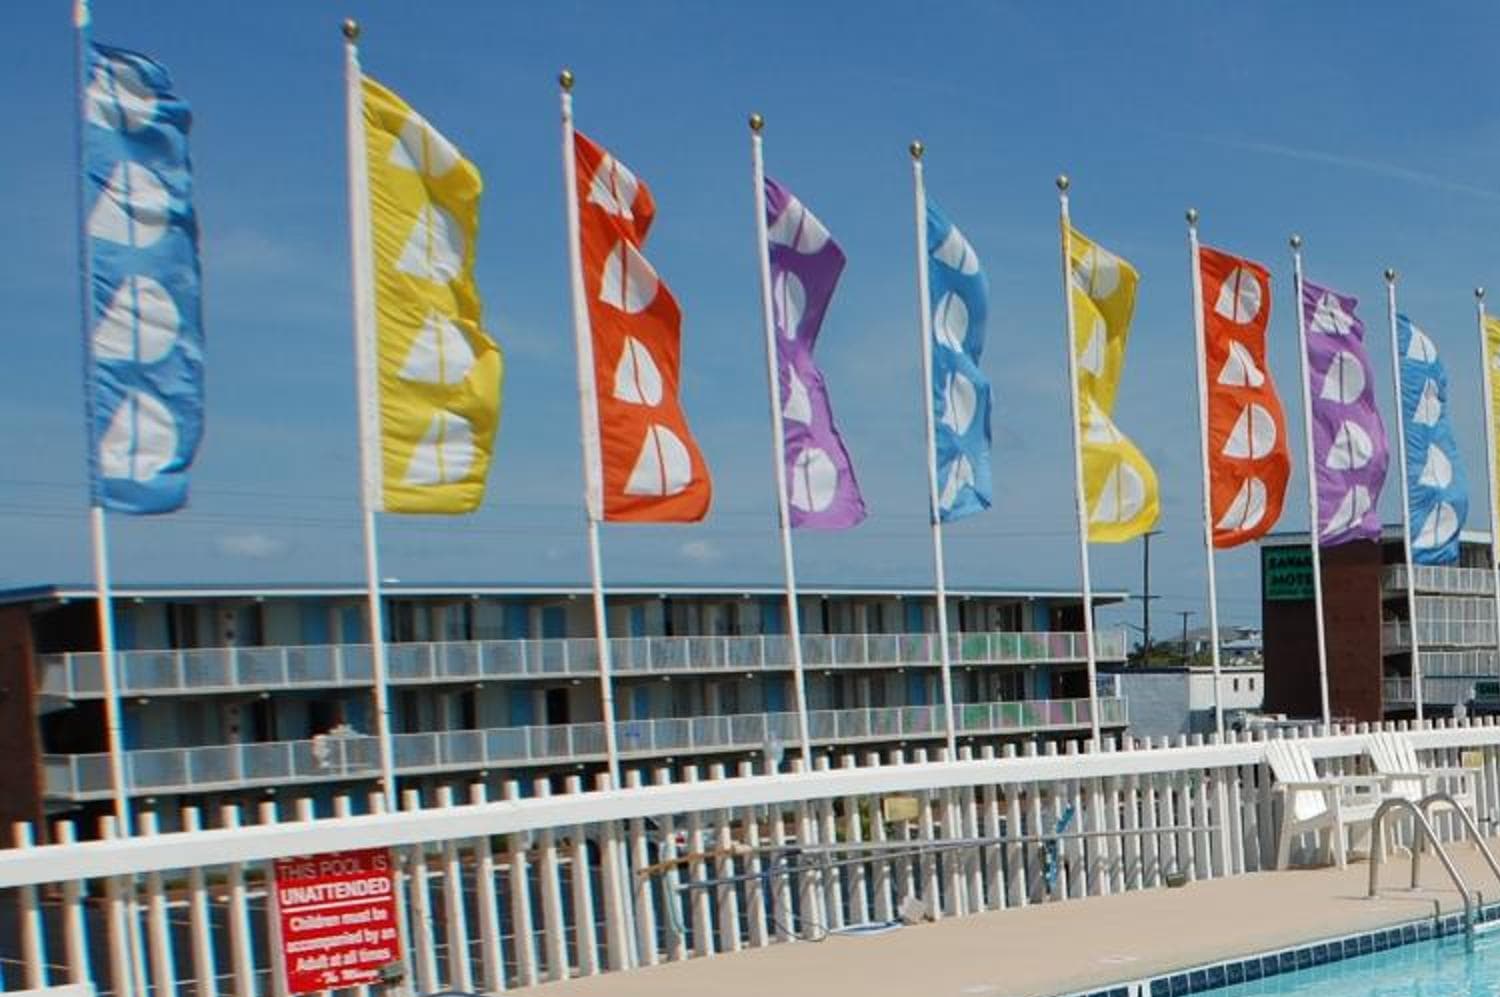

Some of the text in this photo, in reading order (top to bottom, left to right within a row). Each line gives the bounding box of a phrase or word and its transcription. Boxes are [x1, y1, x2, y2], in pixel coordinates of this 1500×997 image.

[279, 855, 387, 880] THIS POOL IS
[281, 877, 391, 905] UNATTENDED
[290, 912, 340, 932] Children
